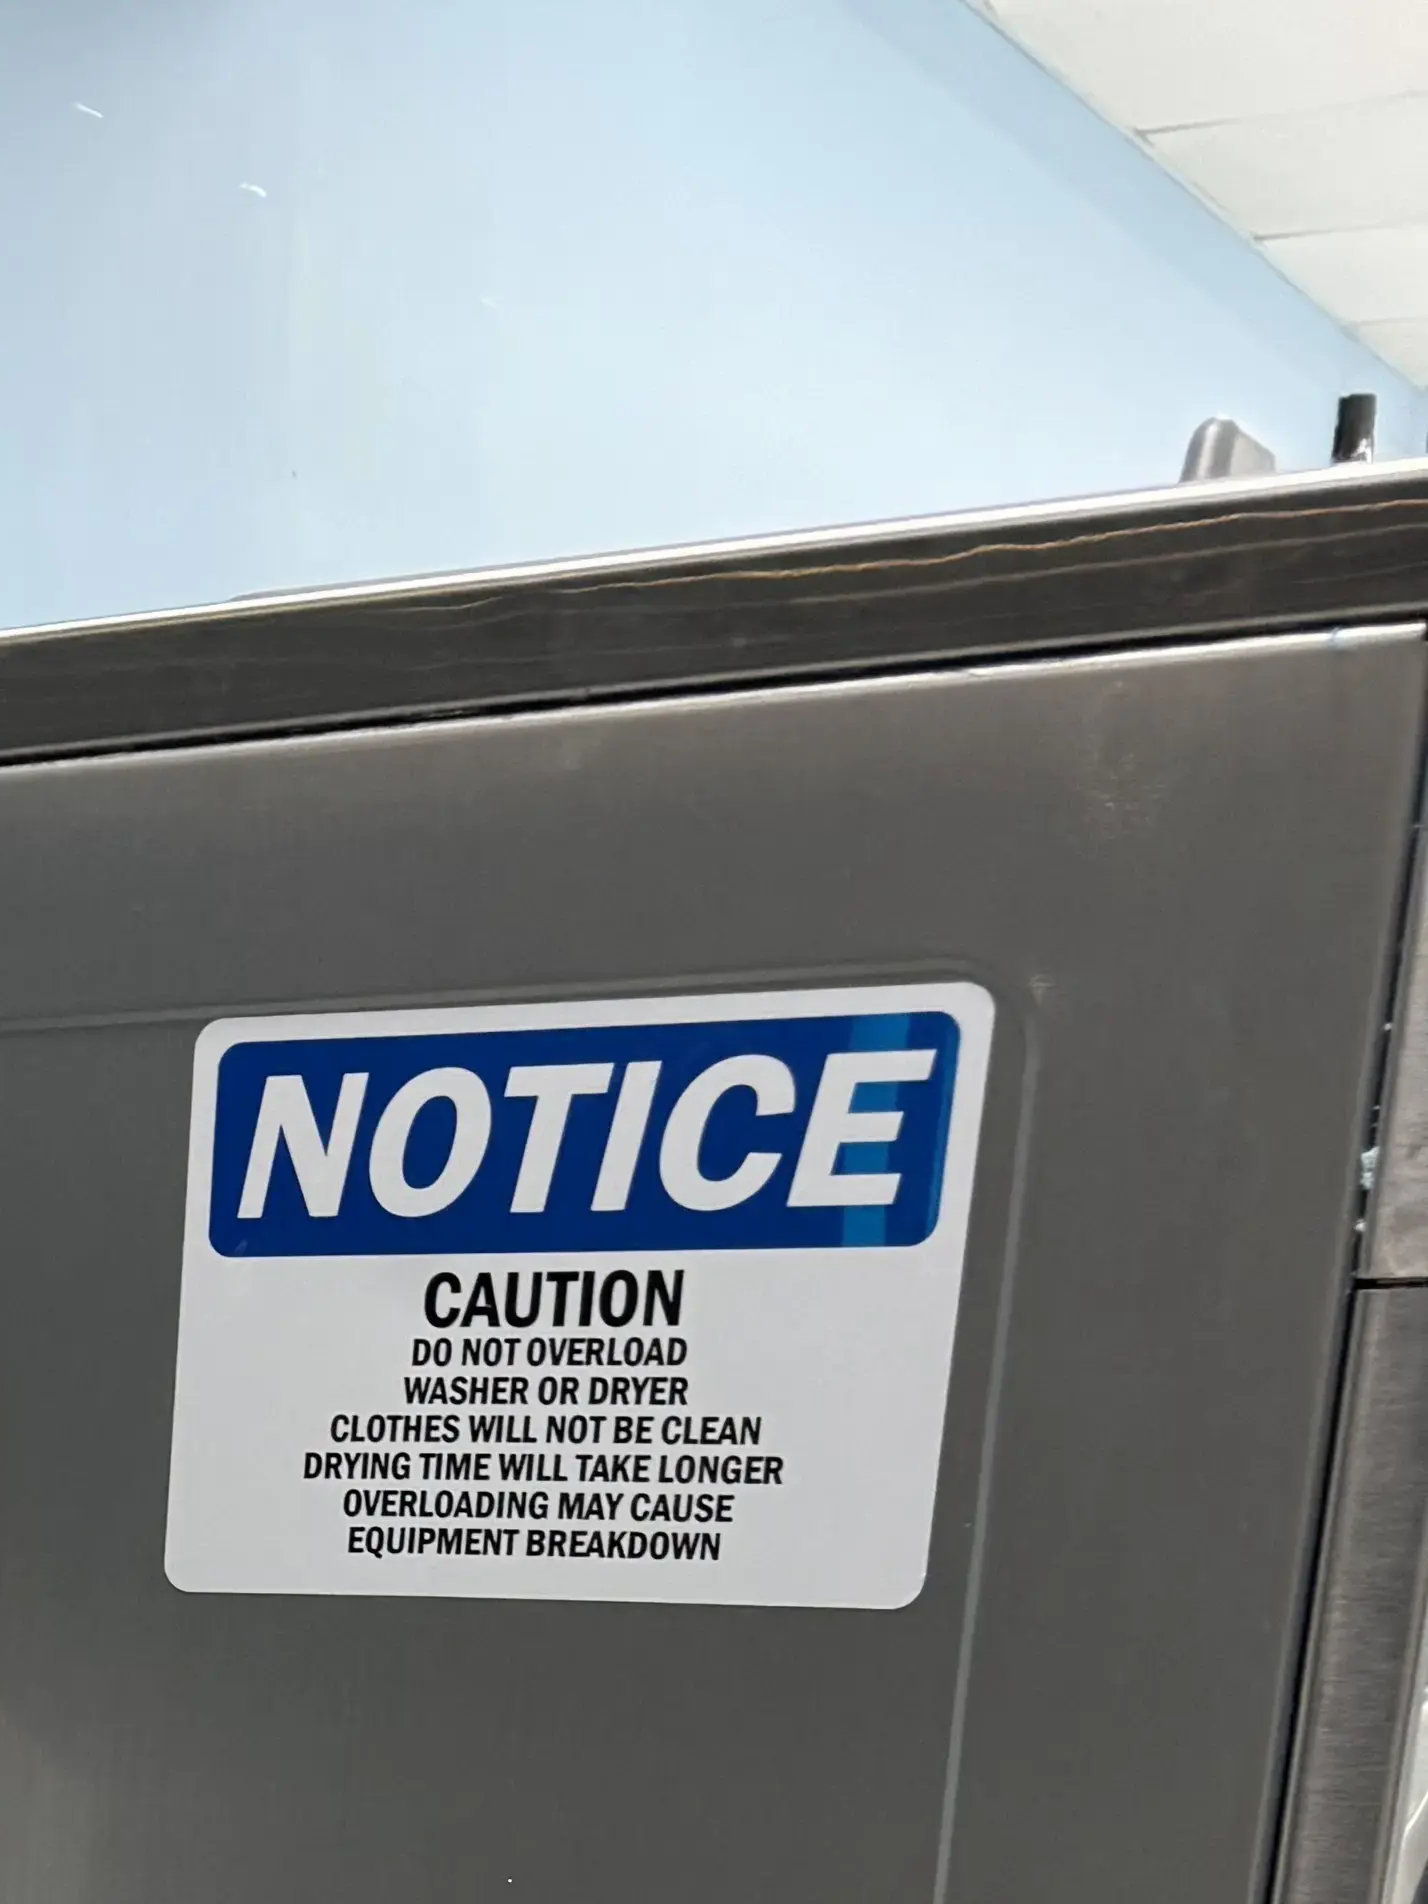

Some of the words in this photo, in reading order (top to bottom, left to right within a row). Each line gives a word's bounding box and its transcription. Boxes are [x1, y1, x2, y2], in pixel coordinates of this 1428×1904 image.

[237, 1048, 937, 1219] NOTICE
[424, 1270, 684, 1328] CAUTION
[412, 1338, 451, 1366] DO
[462, 1338, 521, 1366] NOT
[527, 1337, 687, 1366] OVERLOAD
[404, 1377, 529, 1405] WASHER
[539, 1377, 579, 1405] OR
[589, 1377, 689, 1406] DRYER
[330, 1414, 460, 1443] CLOTHES
[469, 1415, 537, 1443] WILL
[545, 1415, 606, 1444] NOT
[613, 1416, 653, 1444] BE
[661, 1416, 762, 1446] CLEAN
[303, 1452, 411, 1480] DRYING
[420, 1453, 491, 1481] TIME
[499, 1453, 568, 1482] WILL
[576, 1454, 651, 1483] TAKE
[658, 1455, 784, 1485] LONGER
[343, 1489, 548, 1520] OVERLOADING
[557, 1492, 622, 1521] MAY
[630, 1493, 735, 1523] CAUSE
[347, 1526, 520, 1559] EQUIPMENT
[526, 1529, 721, 1561] BREAKDOWN
